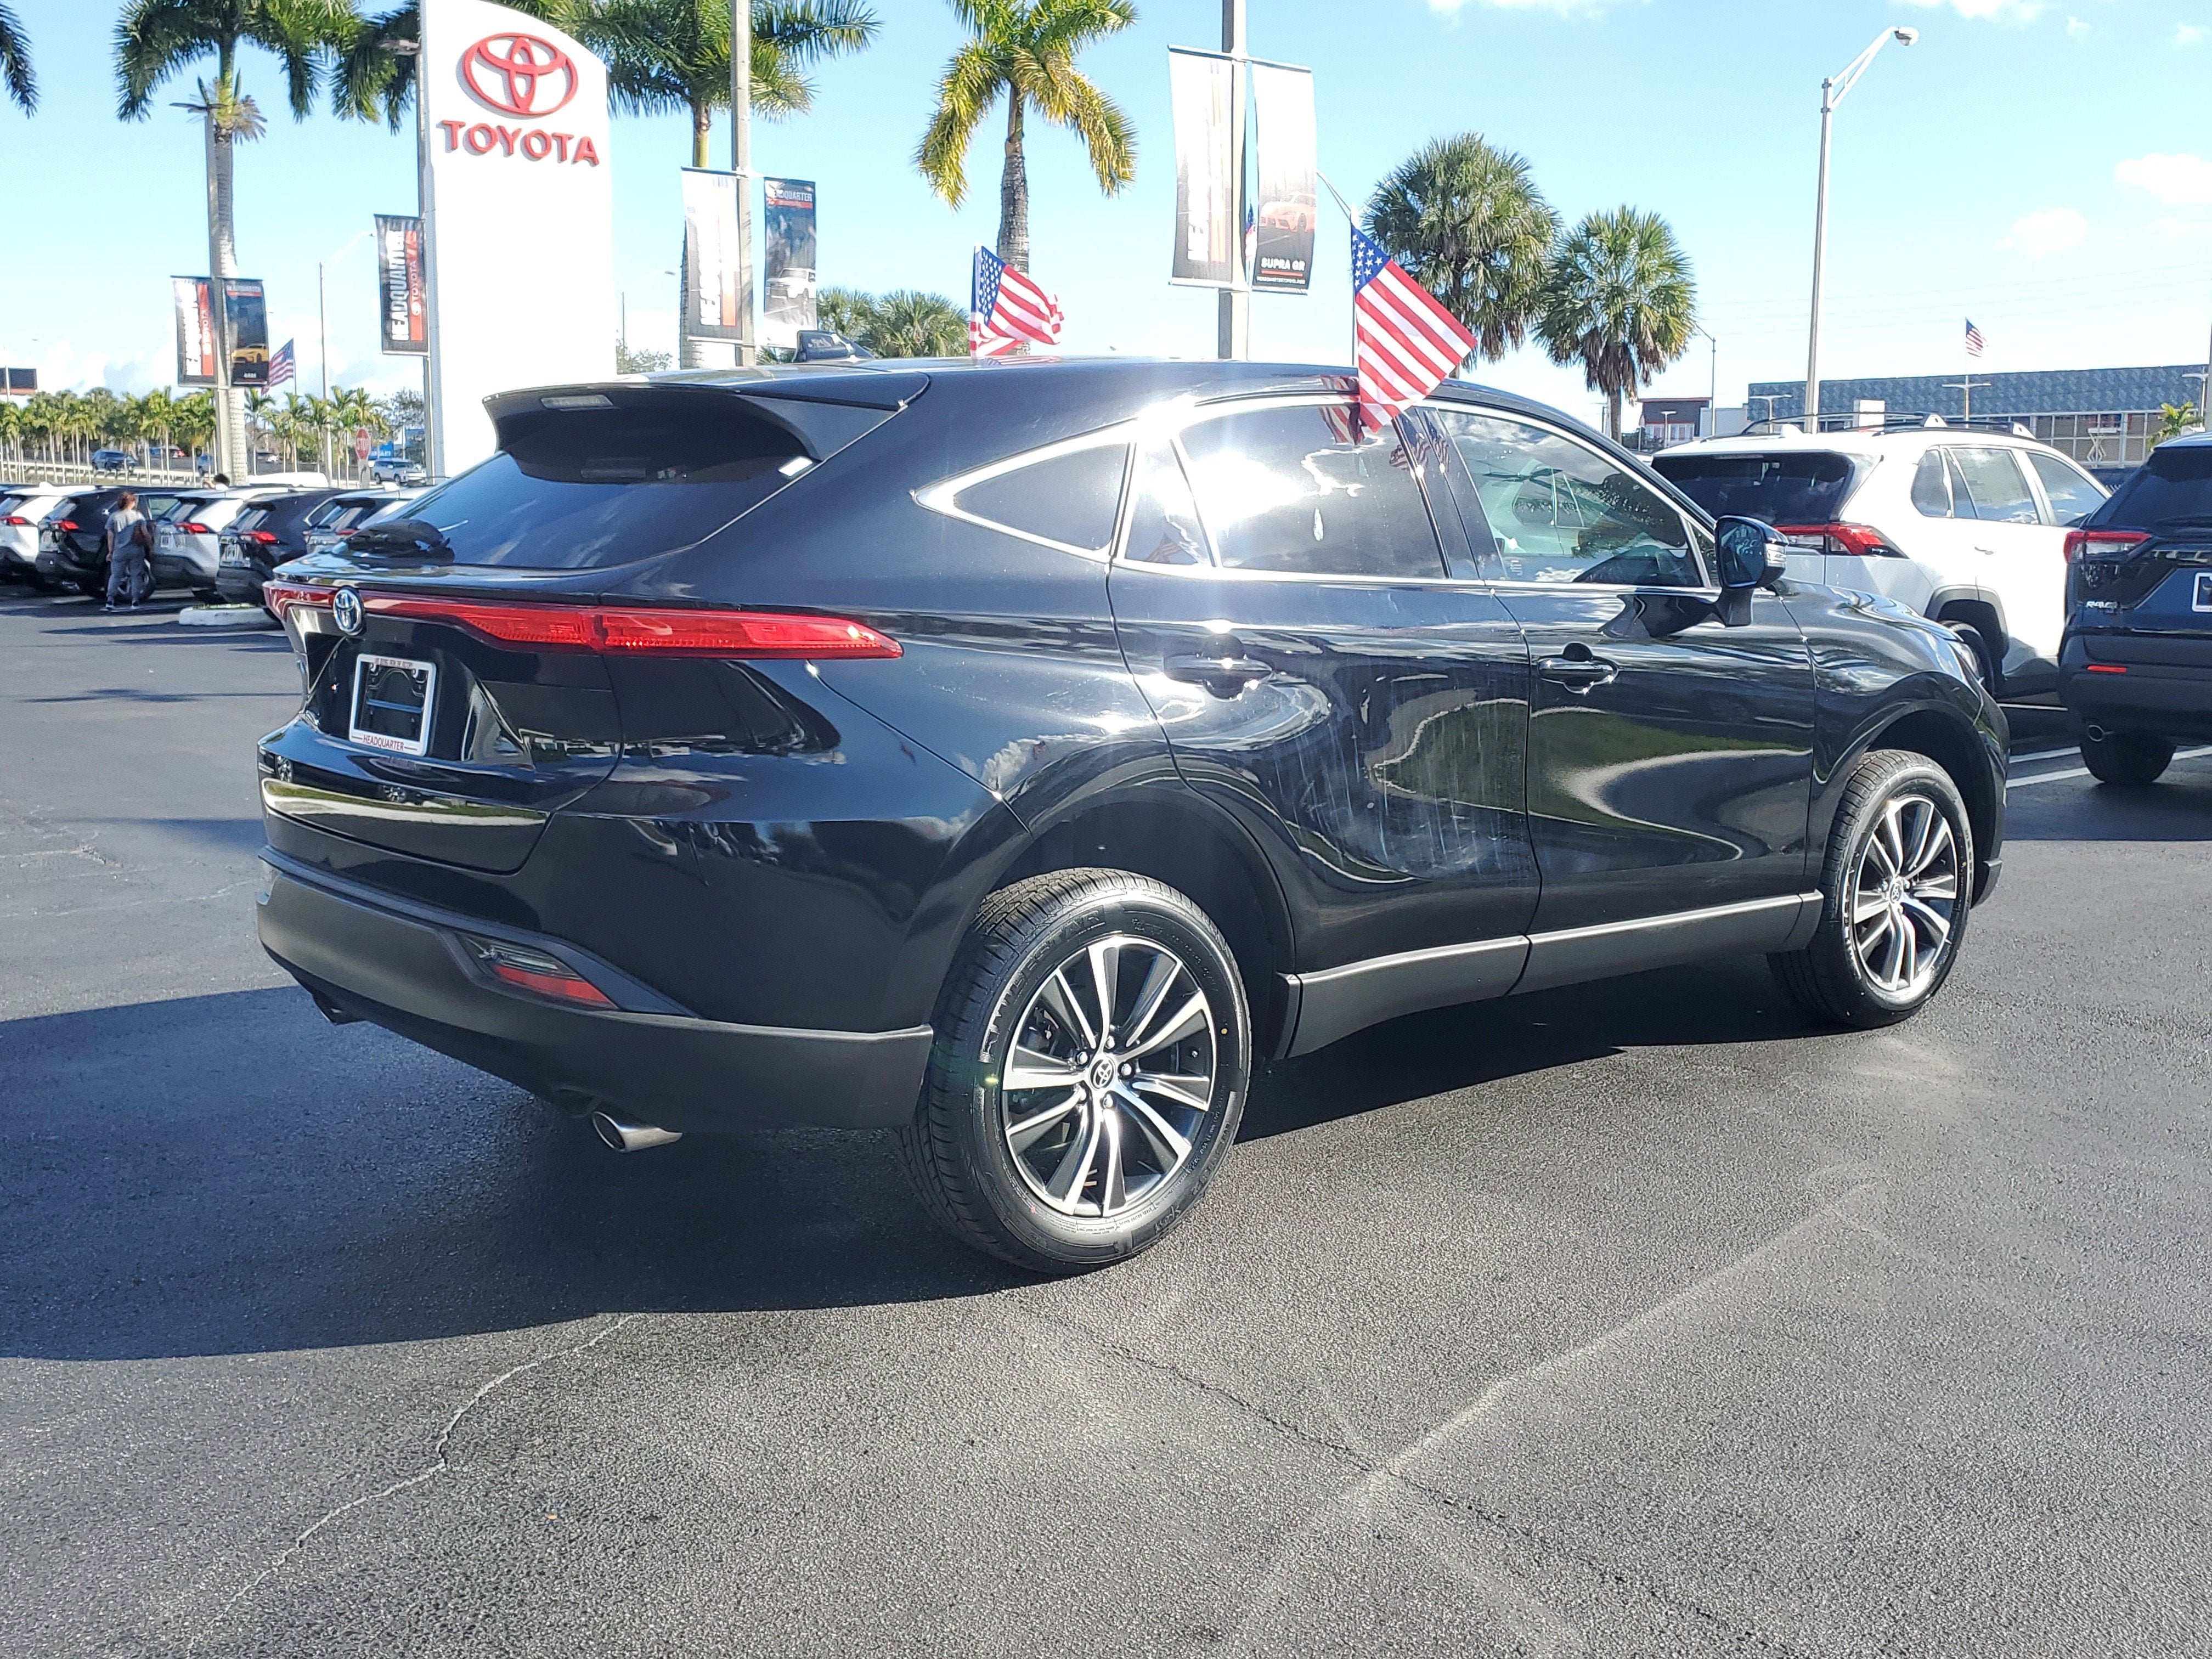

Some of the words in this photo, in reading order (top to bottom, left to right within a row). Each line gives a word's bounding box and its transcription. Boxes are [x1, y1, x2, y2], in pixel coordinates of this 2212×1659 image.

[438, 120, 600, 166] TOYOTA
[1261, 257, 1291, 270] SUPRA
[1292, 260, 1306, 271] GR
[410, 260, 419, 302] TOYOTA
[363, 735, 405, 752] HEADQUARTER
